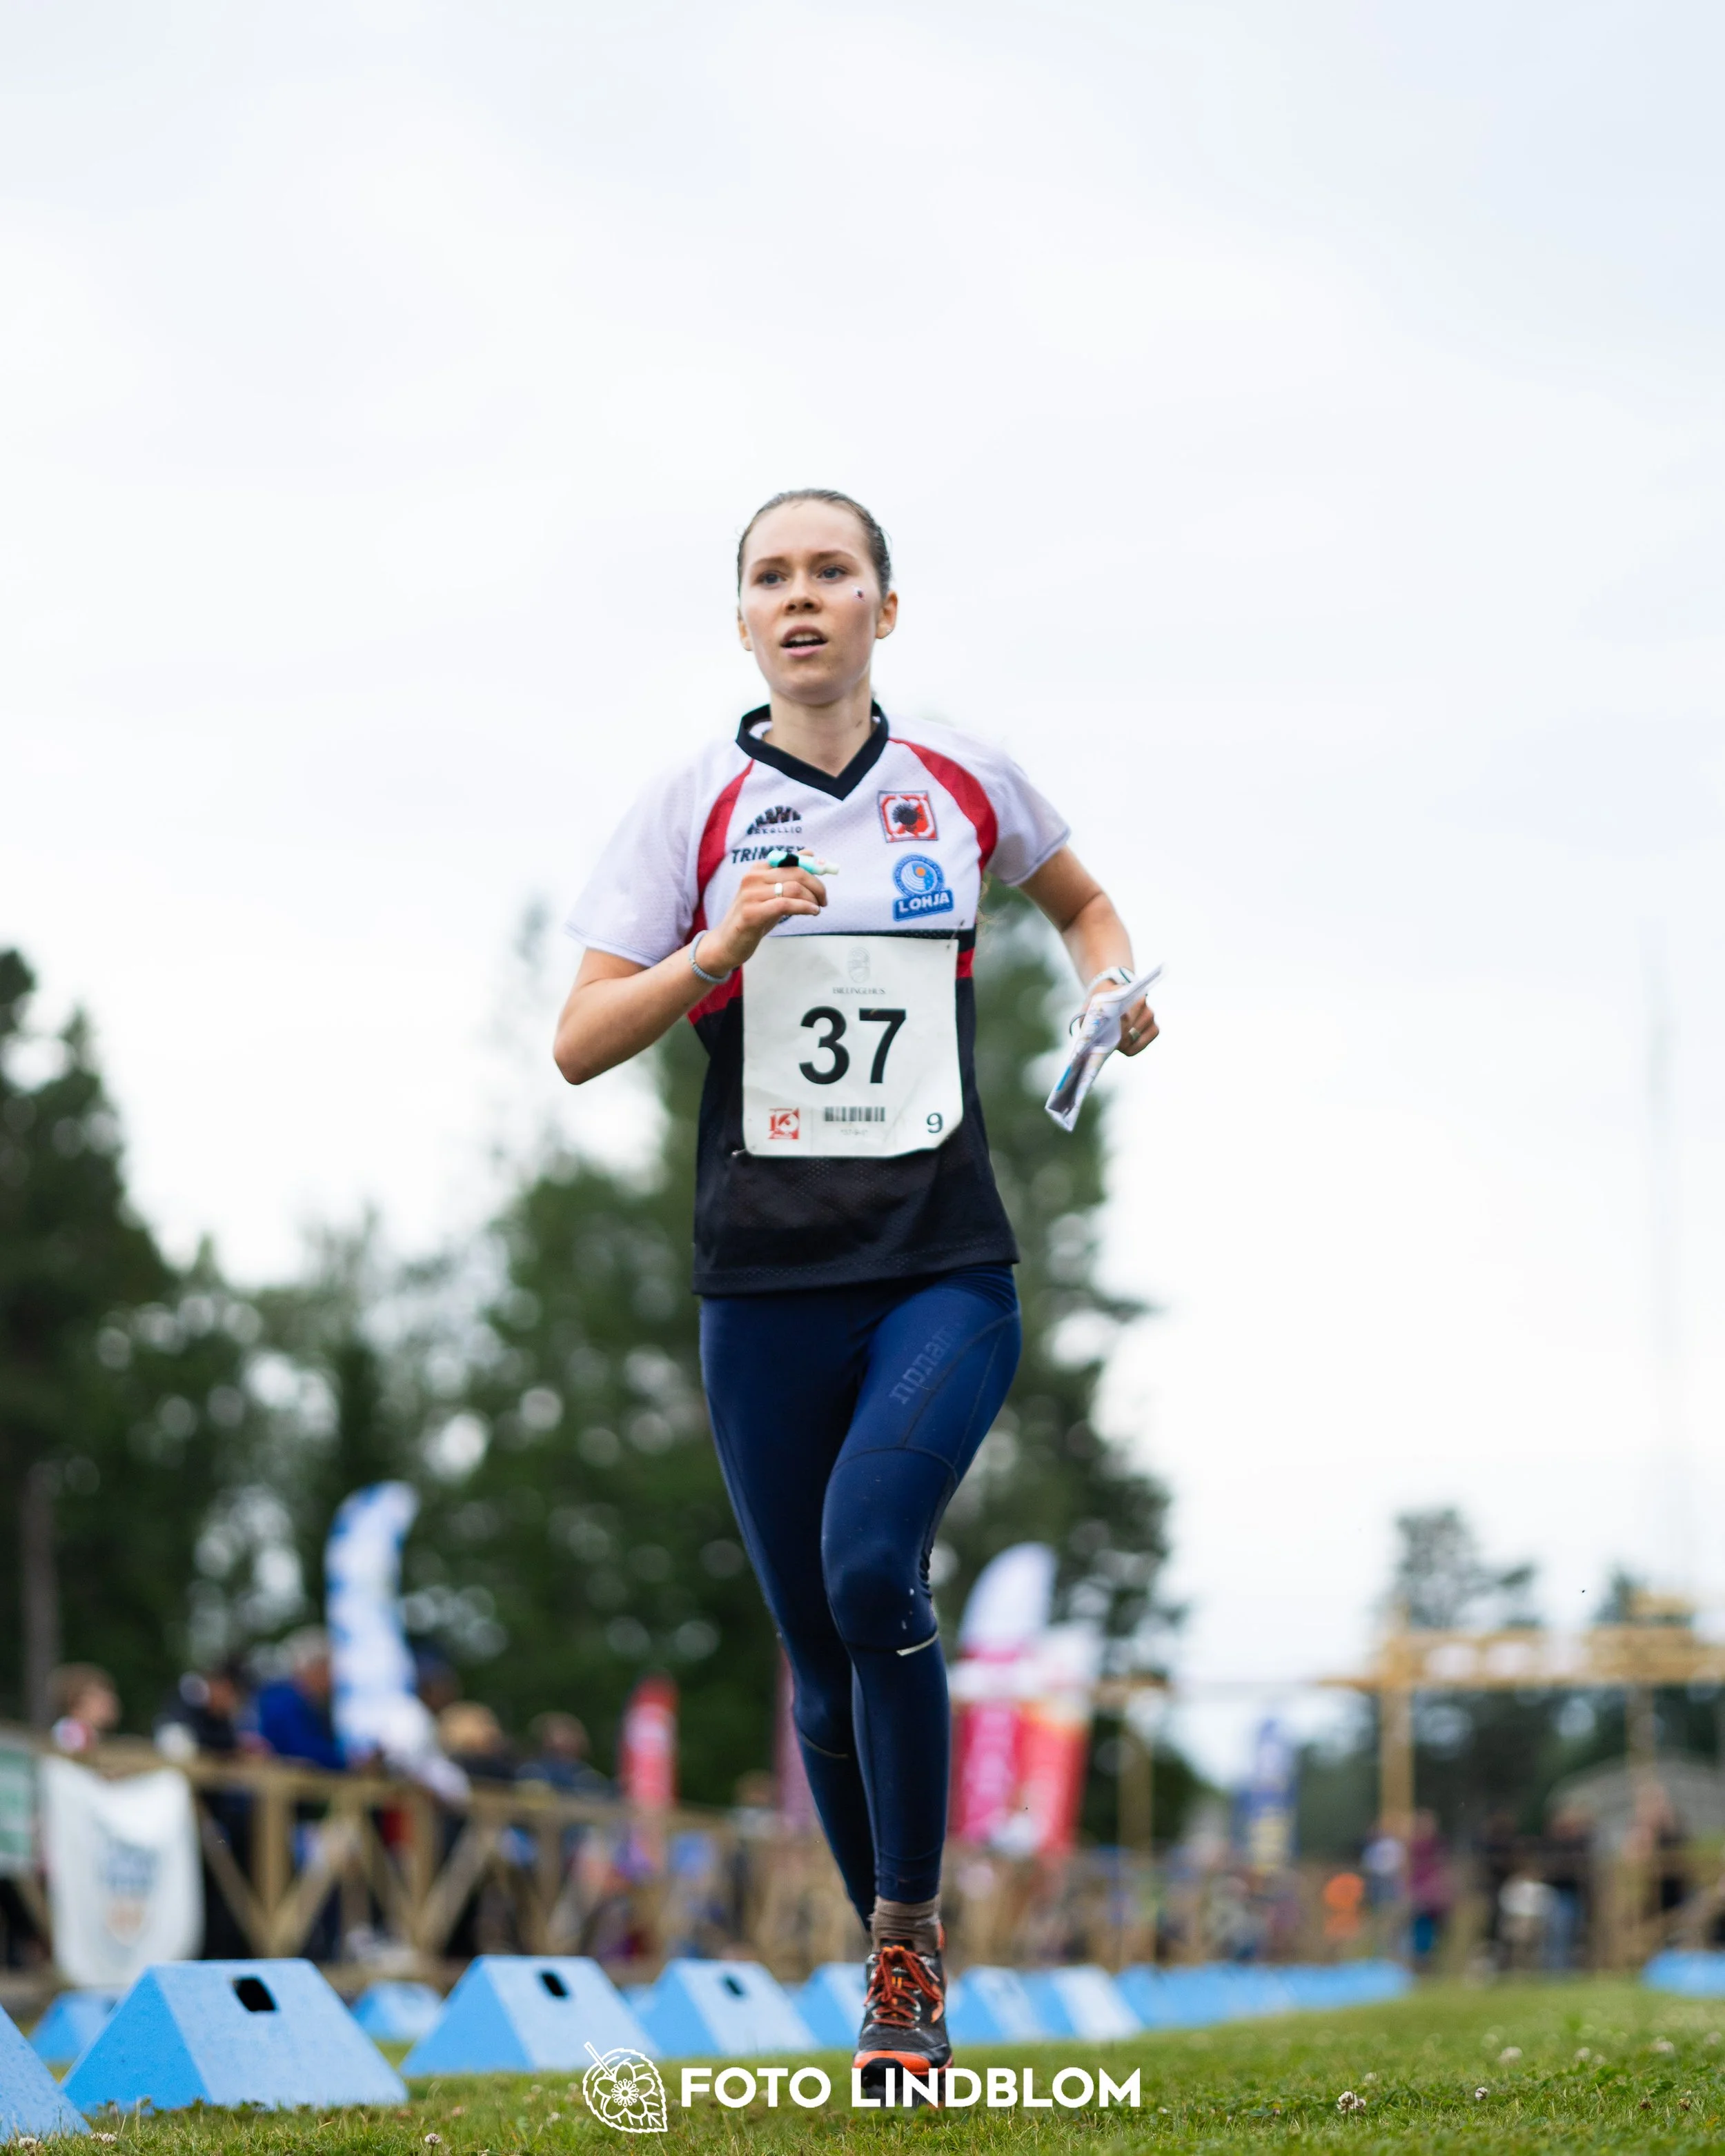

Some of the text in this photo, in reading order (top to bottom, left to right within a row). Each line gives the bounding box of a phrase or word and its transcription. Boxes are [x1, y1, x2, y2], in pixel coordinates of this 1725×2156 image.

[898, 891, 950, 913] LOHJA
[799, 1005, 907, 1085] 37
[926, 1112, 943, 1133] 9
